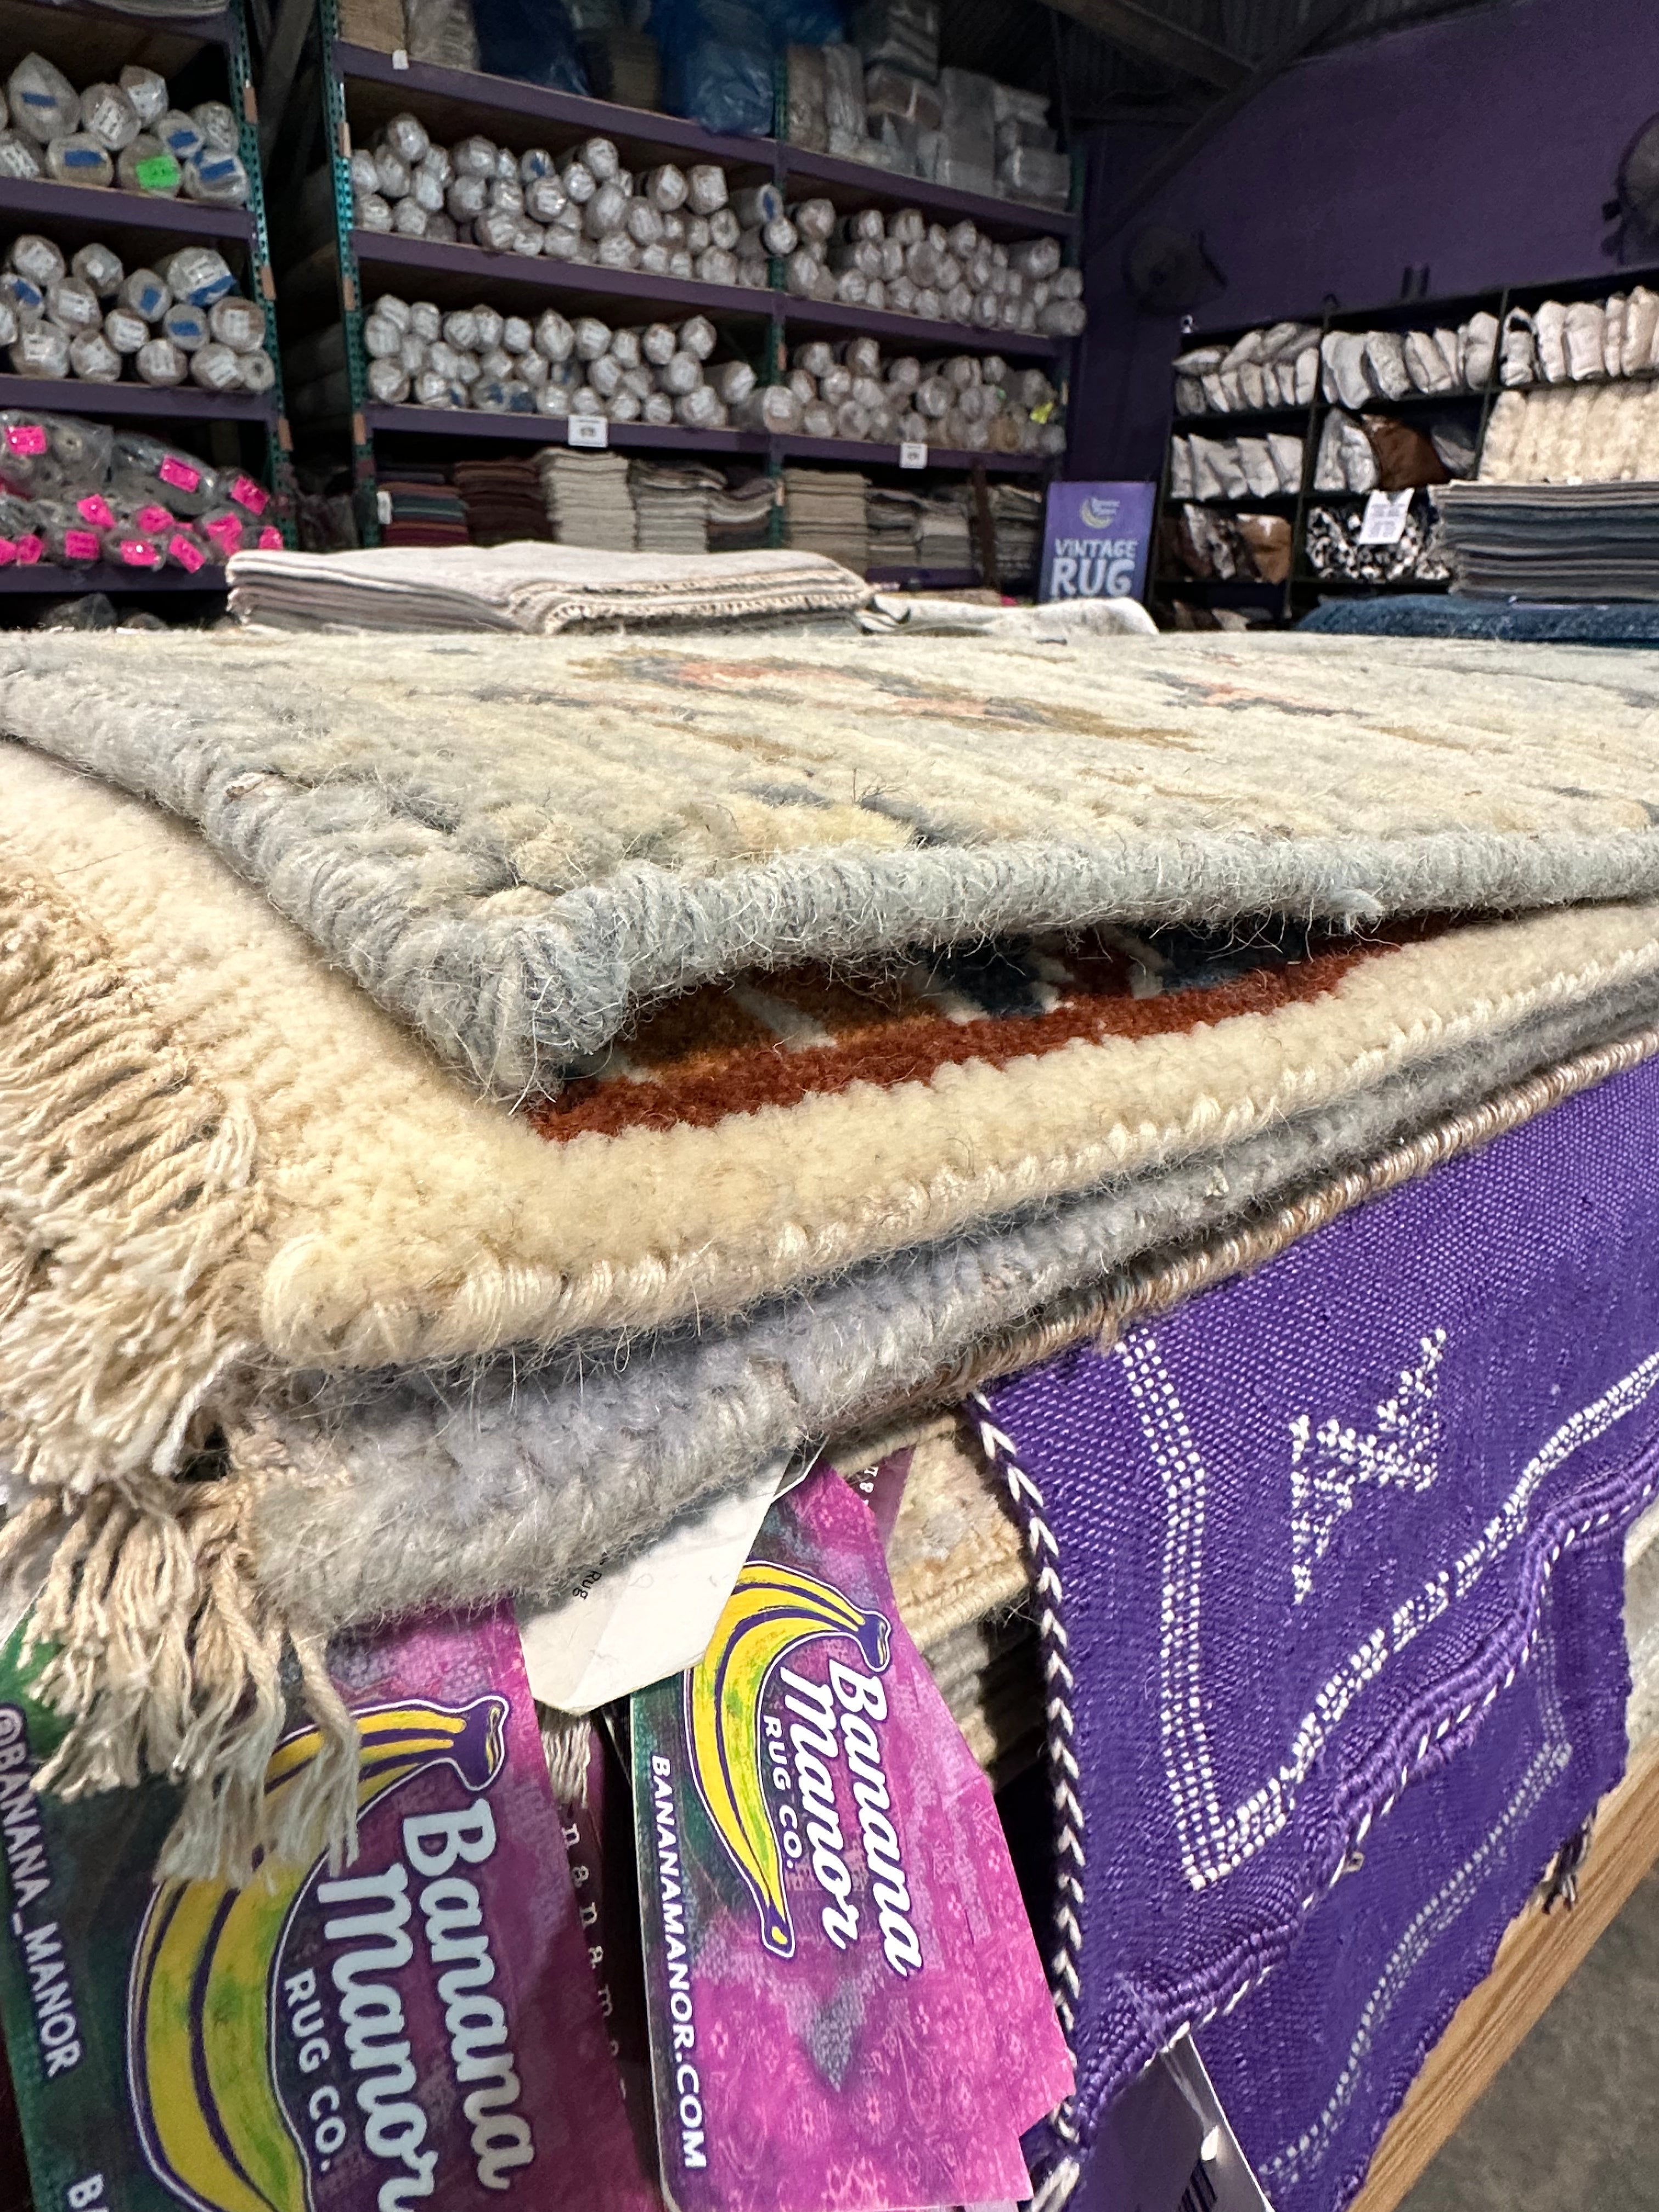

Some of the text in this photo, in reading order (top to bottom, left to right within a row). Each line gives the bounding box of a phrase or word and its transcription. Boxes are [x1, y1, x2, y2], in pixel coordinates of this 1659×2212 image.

[1049, 557, 1136, 597] RUG
[1054, 538, 1139, 558] VINTAGE
[763, 1714, 802, 1869] RUG CO.
[780, 1667, 860, 1950] Manor
[828, 1658, 924, 1976] Banana
[284, 1967, 347, 2172] RUG CO.
[317, 1863, 439, 2212] Manor
[403, 1798, 534, 2191] Banana
[652, 1755, 707, 2169] BANANAMANOR.COM
